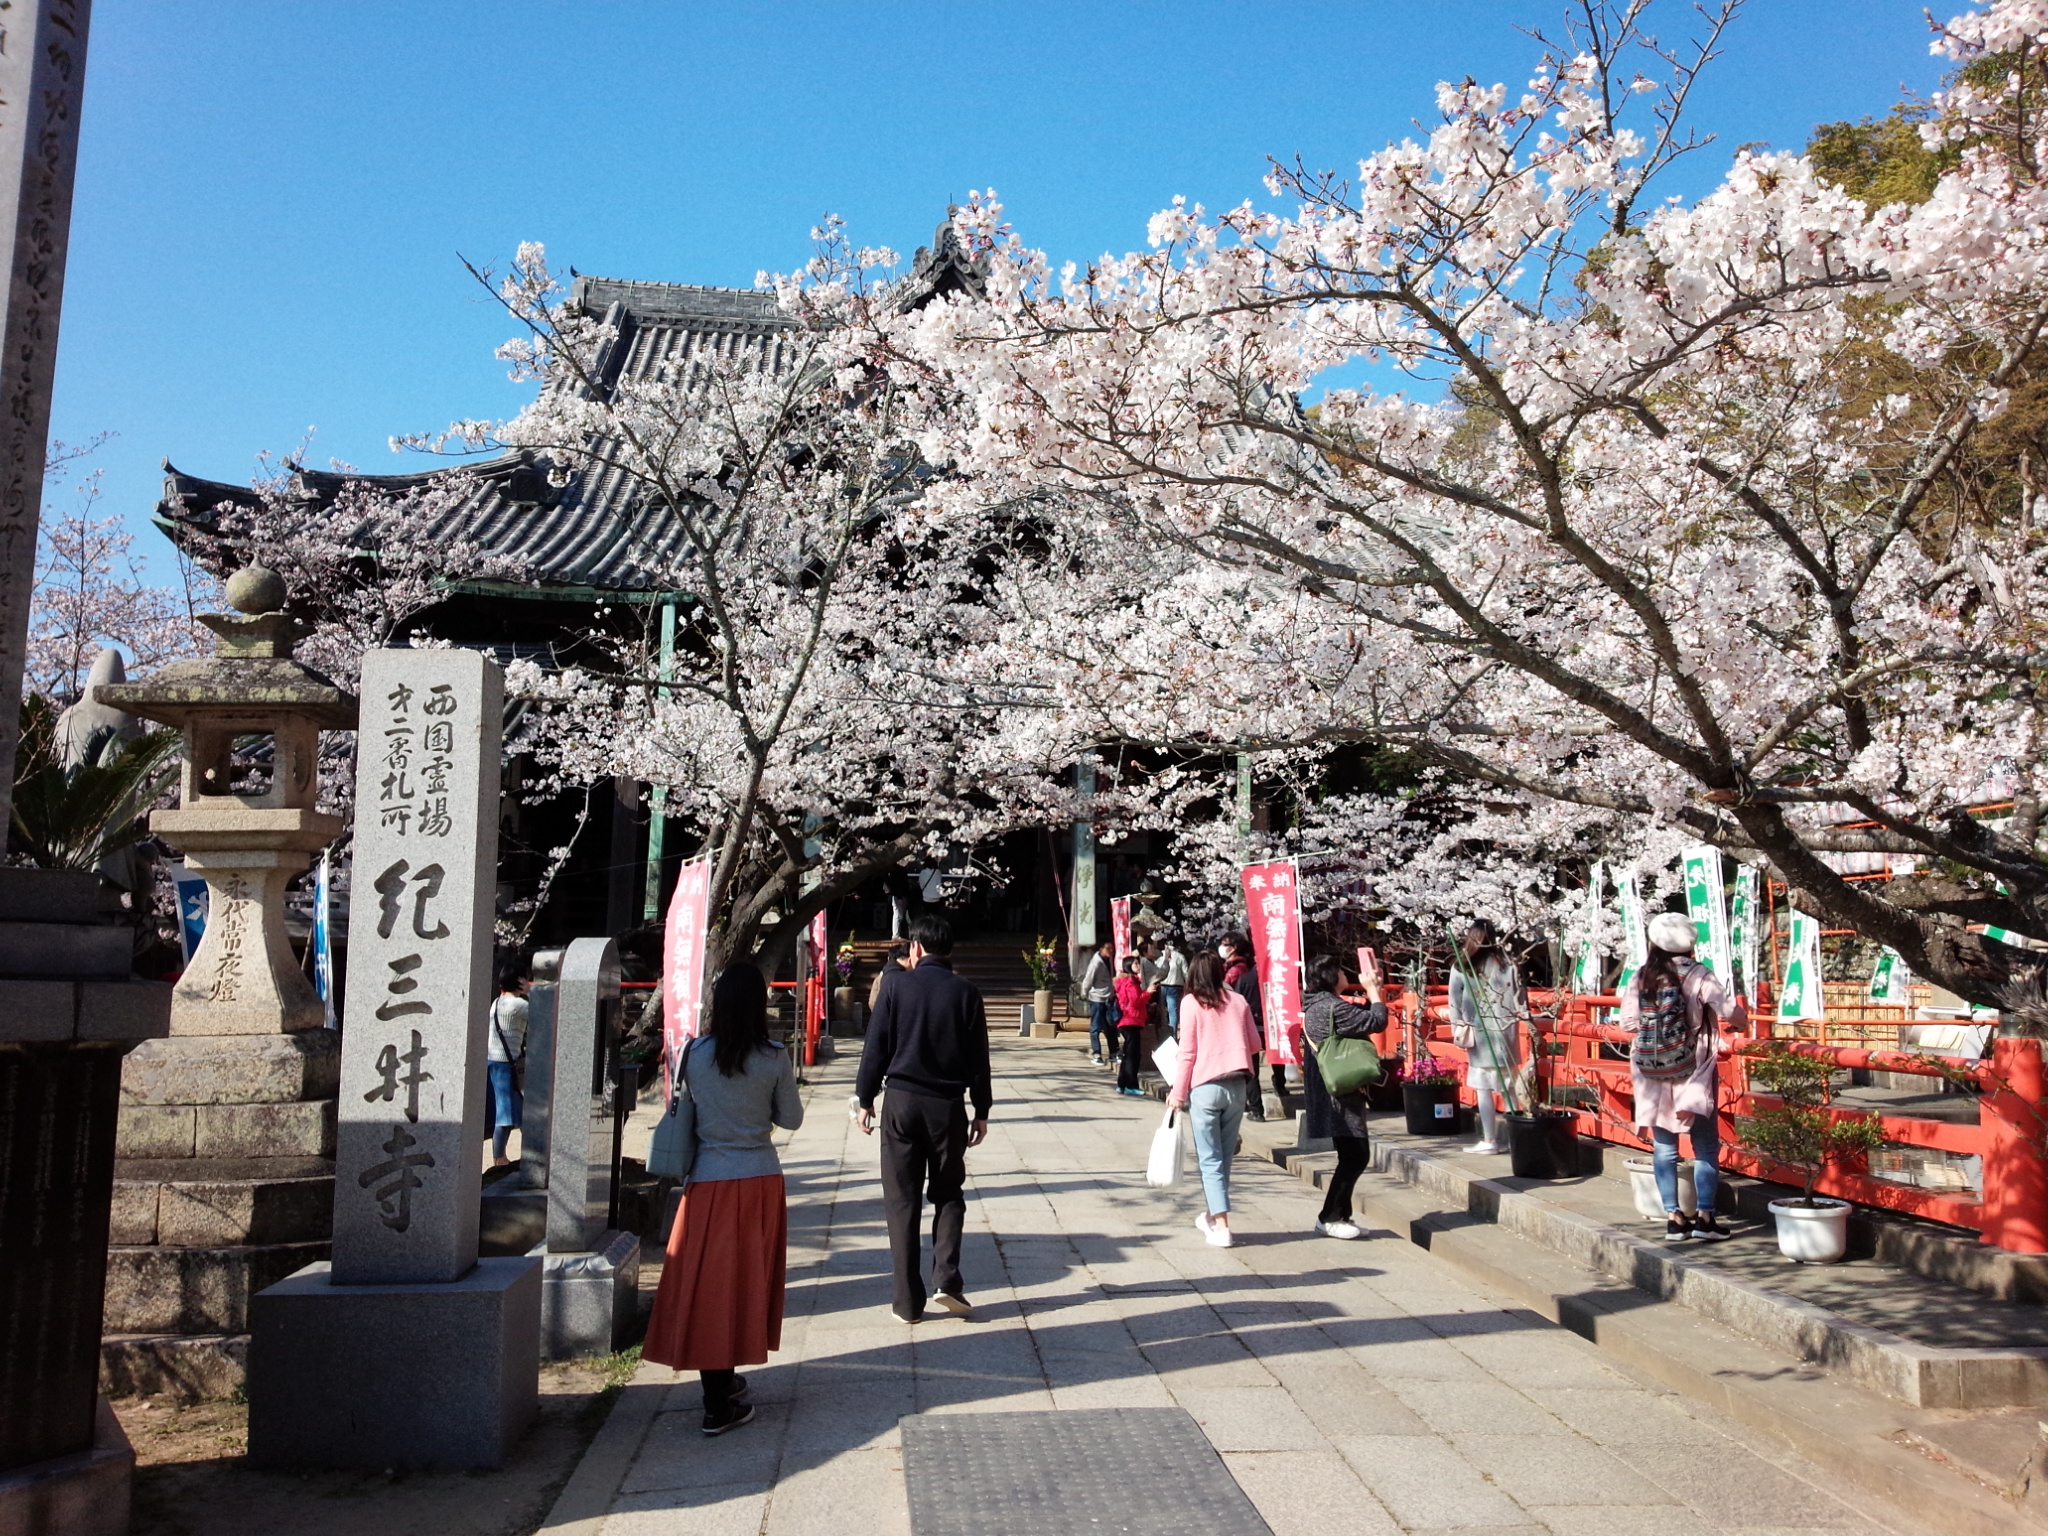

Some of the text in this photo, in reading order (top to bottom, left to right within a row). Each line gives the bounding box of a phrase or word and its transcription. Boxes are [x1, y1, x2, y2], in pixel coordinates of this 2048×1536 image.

[418, 684, 458, 838] 西国霊場
[1249, 872, 1290, 891] 奉納
[357, 858, 451, 1234] 紀三井寺
[672, 902, 694, 1048] 南無観世
